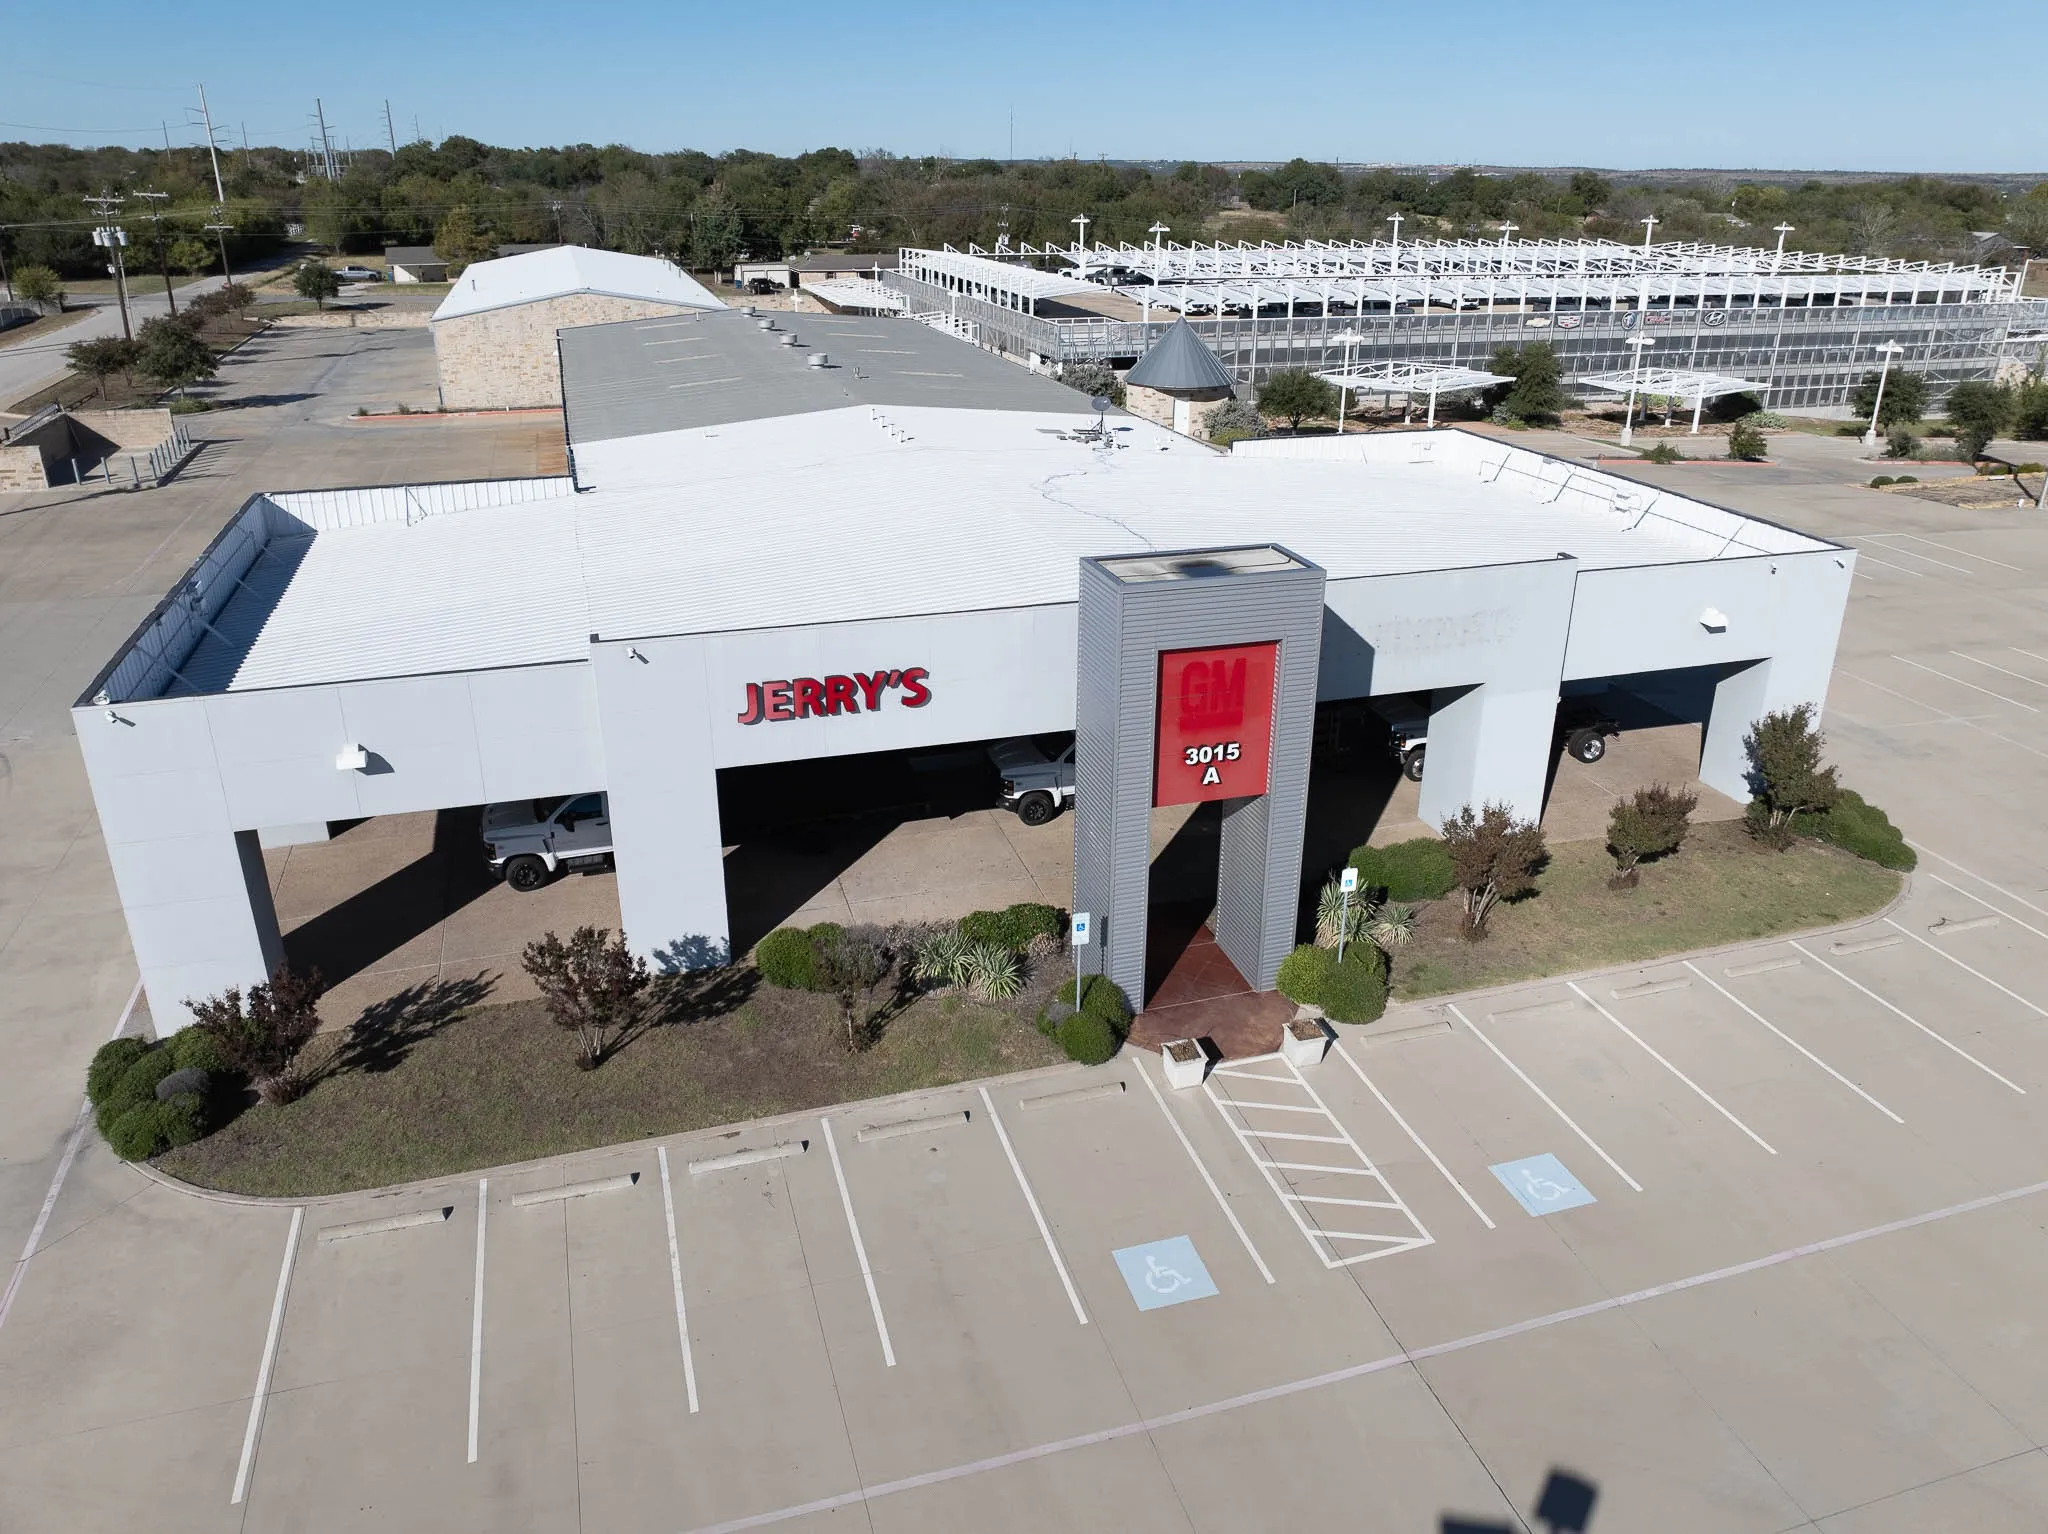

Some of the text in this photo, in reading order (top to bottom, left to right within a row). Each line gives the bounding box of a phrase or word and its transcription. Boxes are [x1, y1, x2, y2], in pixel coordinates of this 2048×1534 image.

[737, 667, 932, 725] JERRY'S
[1181, 658, 1247, 714] GM
[1184, 742, 1241, 765] 3015
[1202, 767, 1221, 785] A
